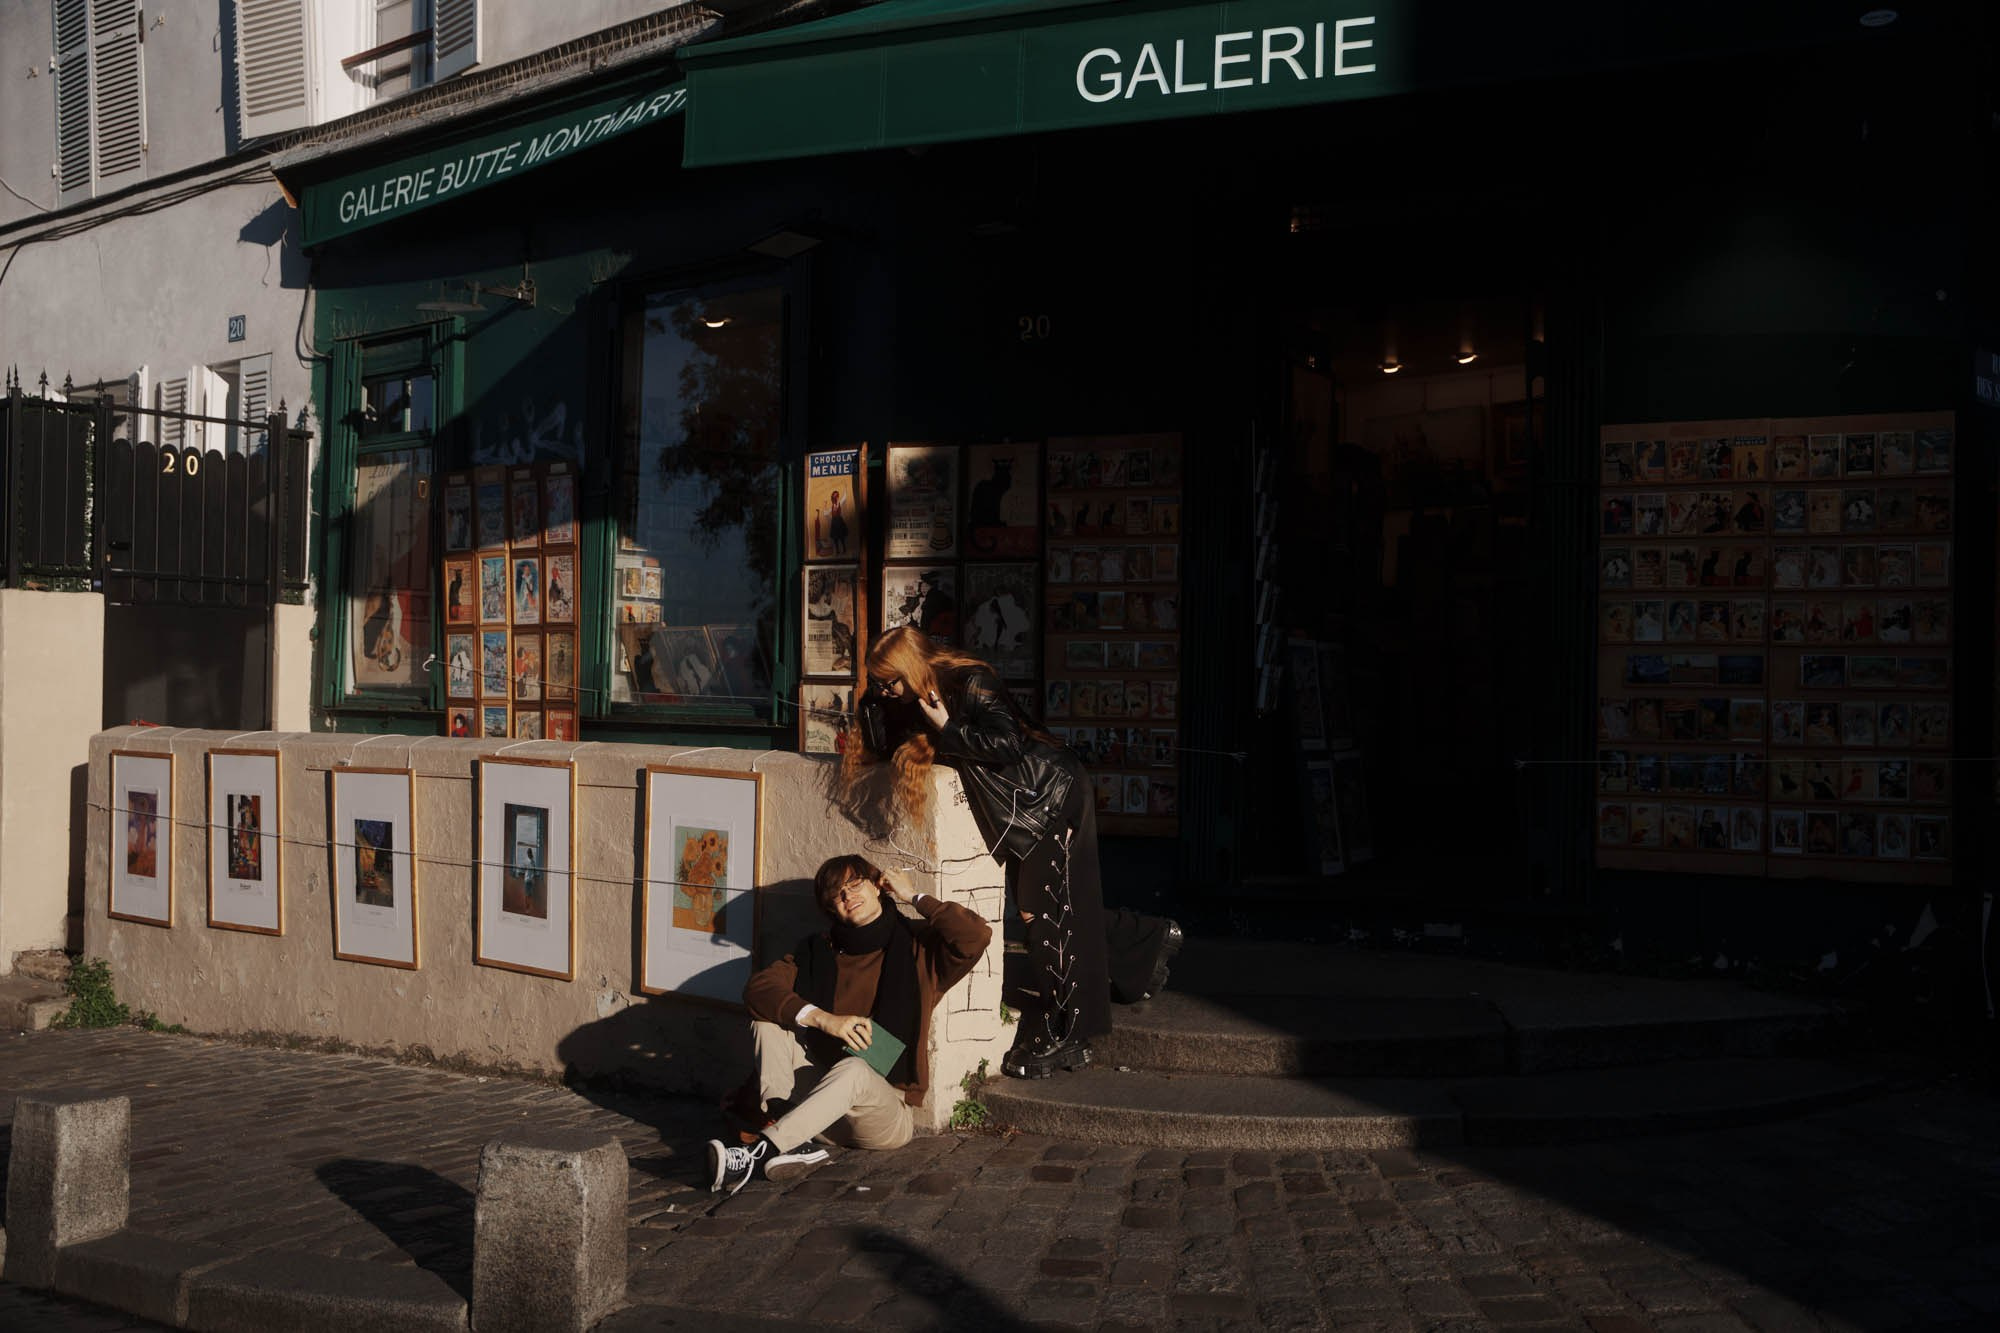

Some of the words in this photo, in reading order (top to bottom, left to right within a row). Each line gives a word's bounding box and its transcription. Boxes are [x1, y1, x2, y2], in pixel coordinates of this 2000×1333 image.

[1076, 16, 1376, 103] GALERIE
[339, 168, 435, 223] GALERIE
[437, 142, 521, 194] BUTTE
[230, 319, 243, 337] 20
[1017, 314, 1051, 341] 20
[162, 452, 199, 476] 20
[812, 463, 855, 477] MENIE
